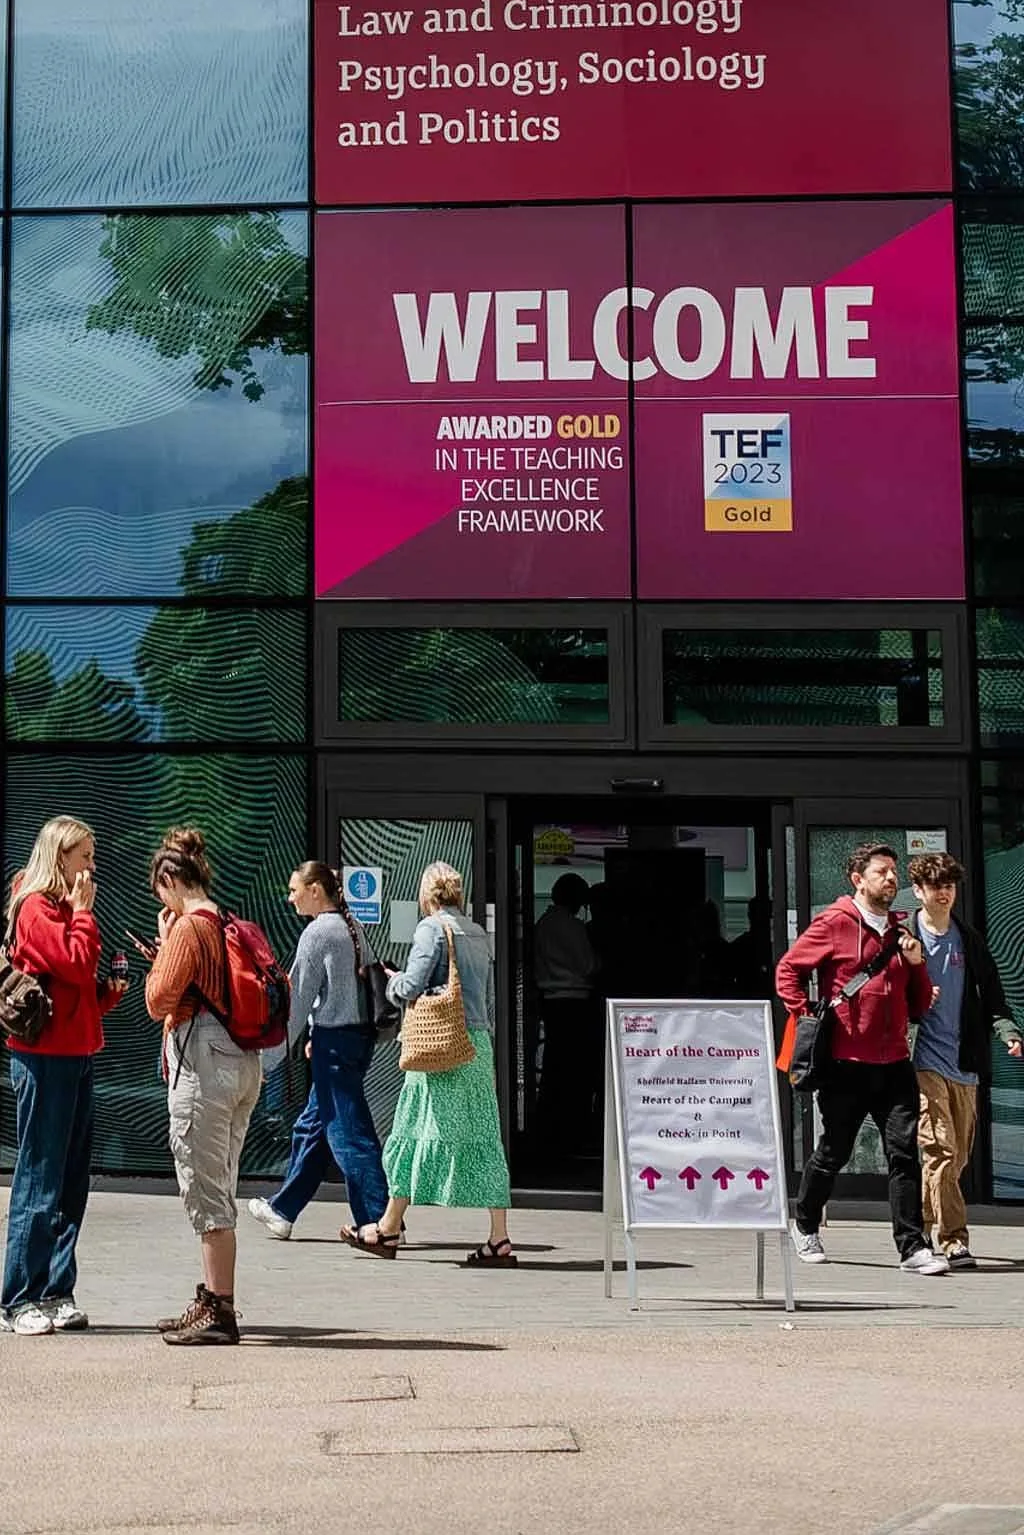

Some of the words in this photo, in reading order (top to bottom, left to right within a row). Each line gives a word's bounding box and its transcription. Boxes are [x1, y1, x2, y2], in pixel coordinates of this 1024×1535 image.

[339, 7, 413, 35] Law
[339, 53, 567, 99] Psychology,
[579, 47, 766, 89] Sociology
[339, 111, 408, 146] and
[419, 109, 559, 143] Politics
[393, 286, 876, 382] WELCOME
[437, 416, 552, 439] AWARDED
[557, 415, 620, 438] GOLD
[710, 428, 784, 459] TEF
[436, 449, 456, 470] IN
[463, 448, 506, 470] THE
[511, 447, 622, 469] TEACHING
[714, 462, 782, 485] 2023
[462, 478, 599, 501] EXCELLENCE
[459, 509, 604, 532] FRAMEWORK
[725, 507, 771, 522] Gold
[626, 1048, 661, 1057] Heart
[666, 1046, 678, 1056] of
[683, 1046, 703, 1056] the
[707, 1047, 759, 1060] Campus
[642, 1096, 671, 1104] Heart
[675, 1096, 685, 1104] of
[689, 1096, 705, 1104] the
[709, 1096, 751, 1107] Campus
[713, 1128, 740, 1138] Point
